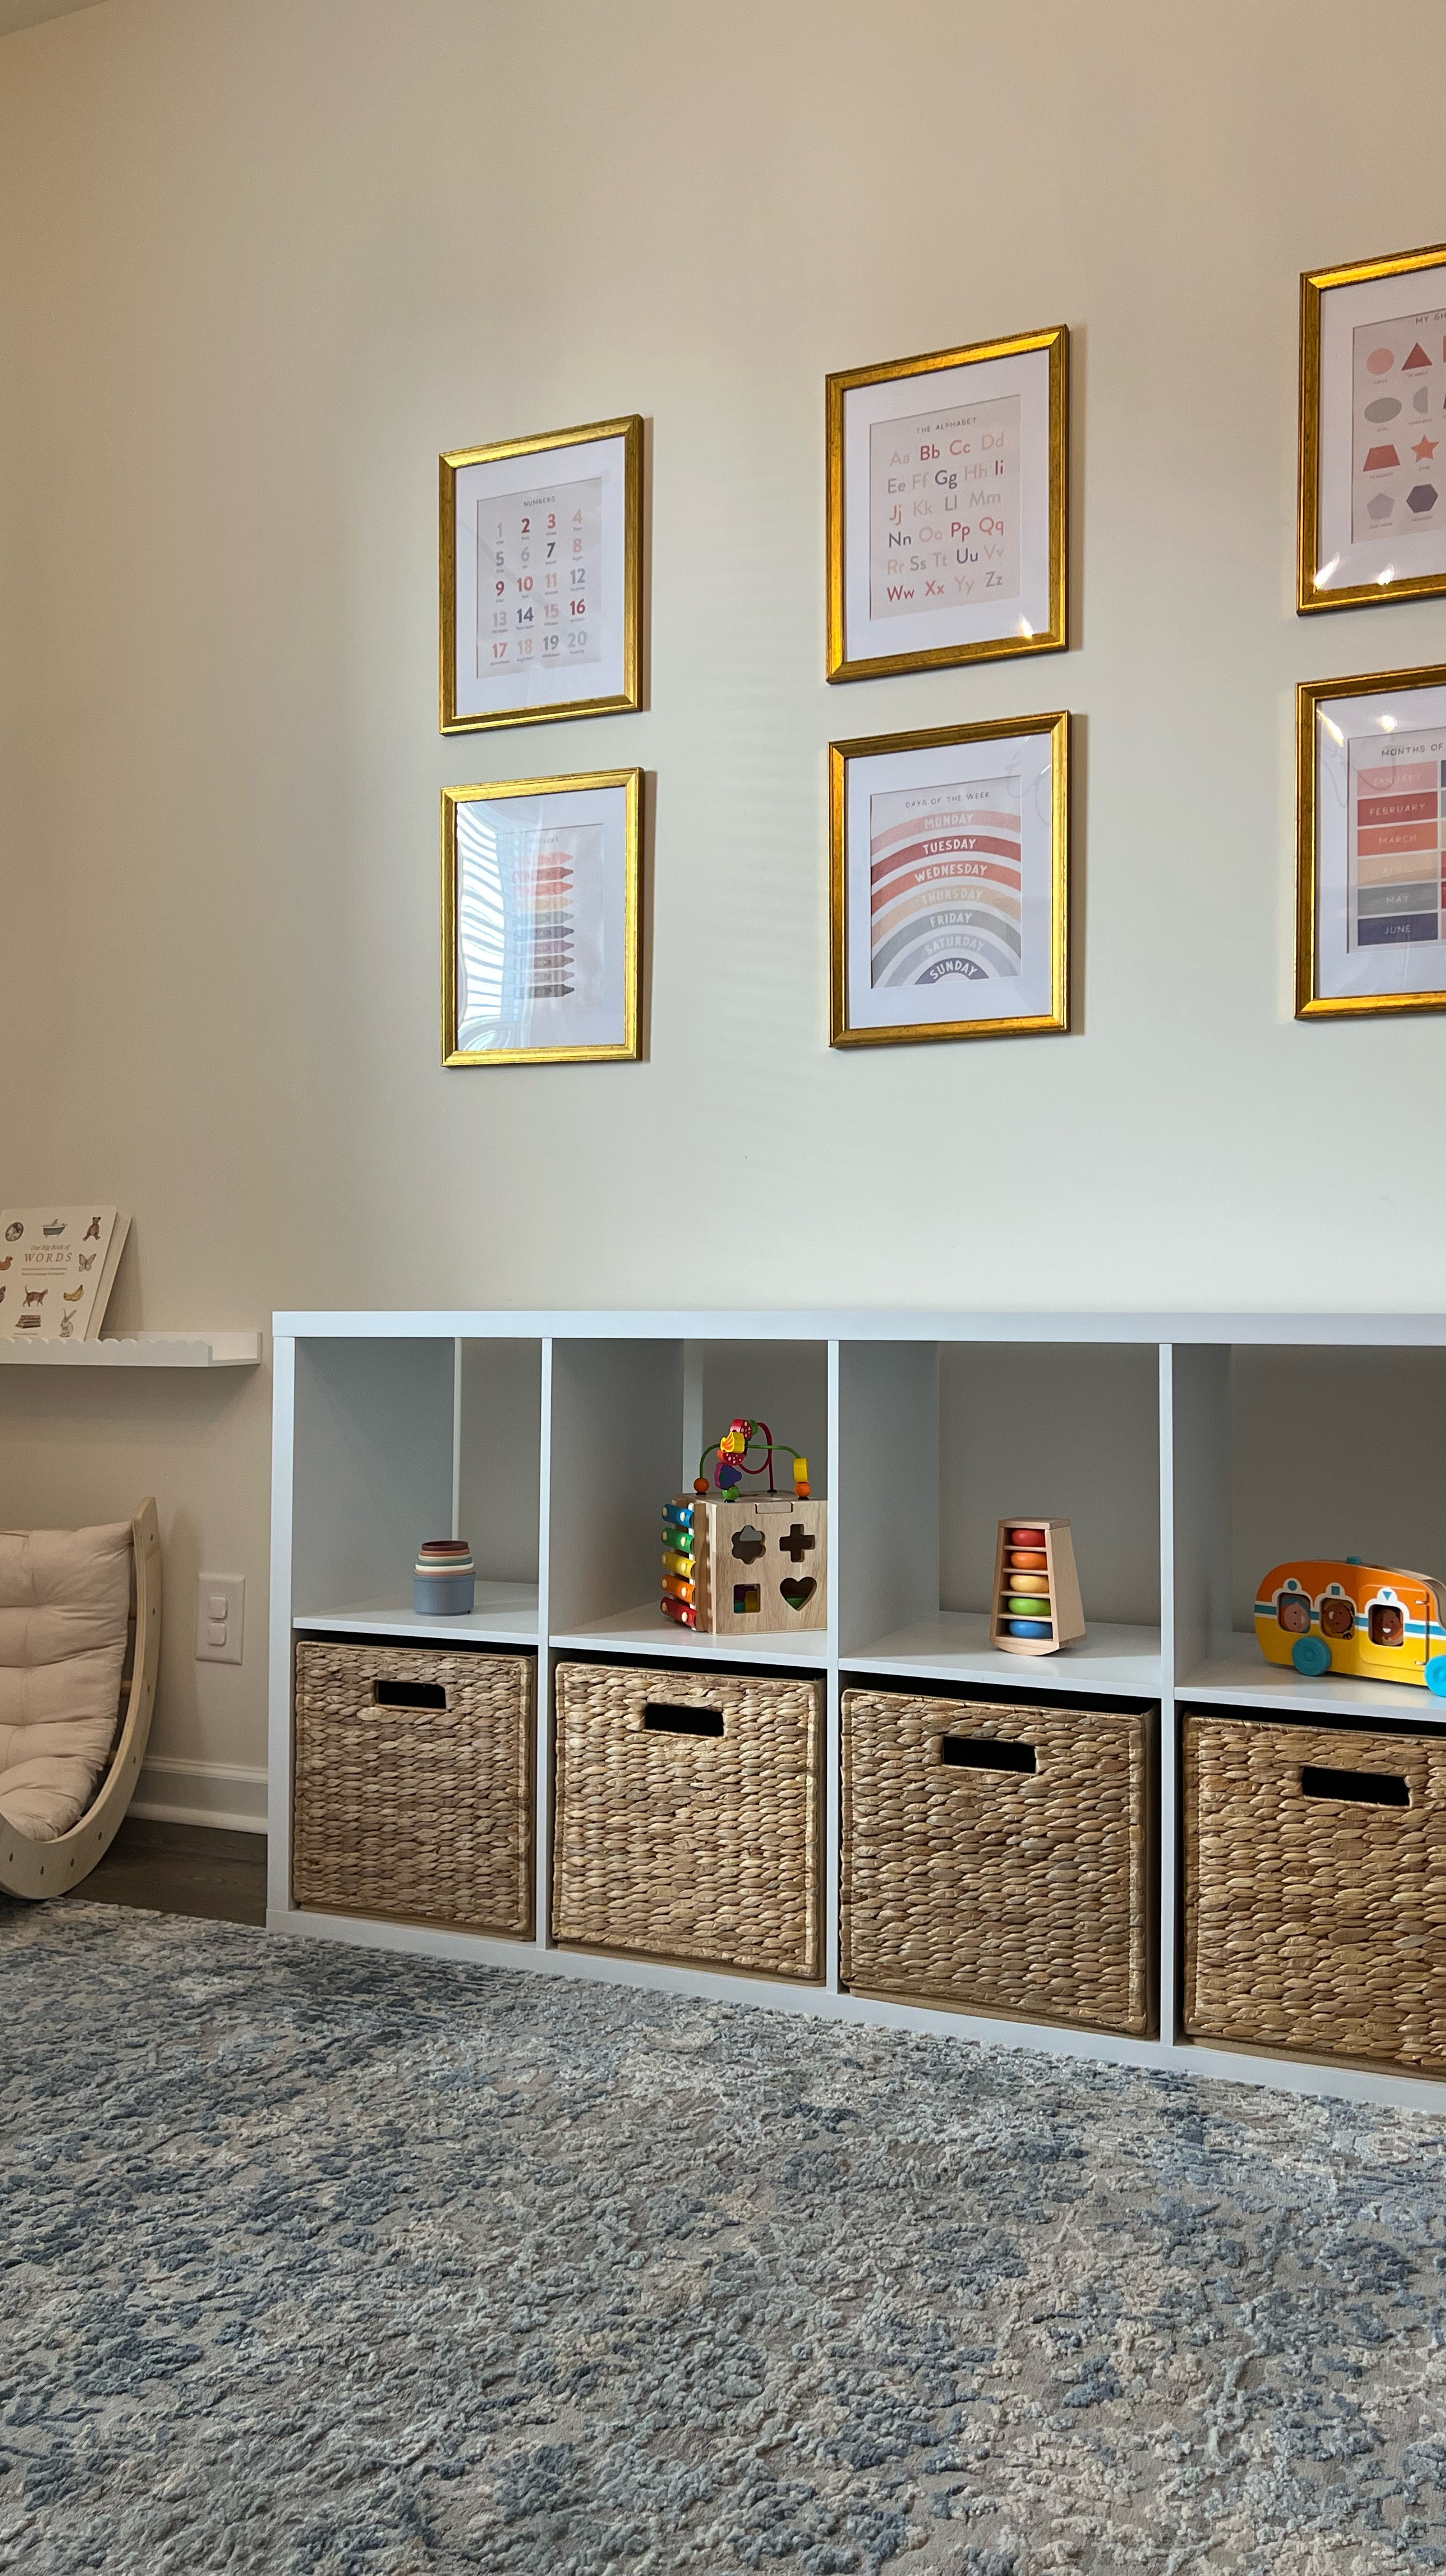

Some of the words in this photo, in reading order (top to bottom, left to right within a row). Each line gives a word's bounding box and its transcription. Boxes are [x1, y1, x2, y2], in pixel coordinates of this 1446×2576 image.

[1415, 316, 1429, 325] MY
[917, 425, 931, 434] THE
[936, 417, 977, 430] ALPHABET
[890, 452, 910, 466] Aa
[920, 444, 940, 461] Bb
[950, 440, 971, 456] Cc
[981, 432, 1004, 450] Dd
[888, 479, 906, 494] Ee
[912, 472, 929, 490] Ff
[934, 470, 957, 489] Gg
[964, 463, 988, 480] Hh
[523, 496, 556, 507] NUMBERS
[890, 505, 902, 526] Jj
[913, 502, 932, 516] Kk
[945, 495, 957, 511] Ll
[969, 490, 1001, 507] Mm
[497, 523, 503, 537] 1
[521, 518, 530, 533] 2
[547, 513, 556, 529] 3
[572, 508, 582, 523] 4
[889, 532, 911, 548] Nn
[951, 522, 970, 542] Pp
[979, 517, 1004, 536] Qq
[496, 551, 504, 566] 5
[521, 546, 529, 562] 6
[547, 542, 556, 558] 7
[573, 538, 582, 553] 8
[887, 559, 905, 574] Rr
[909, 556, 926, 571] Ss
[932, 552, 948, 567] Tt
[957, 548, 978, 564] Uu
[984, 545, 1003, 559] Vv
[496, 581, 505, 596] 9
[517, 576, 533, 592] 10
[545, 572, 557, 588] 11
[570, 568, 586, 584] 12
[887, 585, 915, 601] Ww
[925, 581, 945, 596] Xx
[954, 576, 976, 596] Yy
[986, 571, 1003, 587] Zz
[492, 611, 507, 627] 13
[517, 607, 534, 623] 14
[544, 603, 559, 620] 15
[570, 599, 585, 615] 16
[492, 642, 508, 658] 17
[517, 638, 533, 654] 18
[544, 635, 559, 650] 19
[567, 631, 587, 648] 20
[1381, 745, 1426, 757] MONTHS
[1431, 743, 1443, 751] OF
[906, 800, 927, 808] DAYS
[1369, 803, 1426, 816] FEBRUARY
[924, 813, 975, 829] MONDAY
[923, 839, 977, 854] TUESDAY
[1378, 834, 1417, 845] MARCH
[914, 864, 988, 884] WEDNESDAY
[921, 888, 984, 905] THURSDAY
[1386, 895, 1410, 903] MAY
[930, 912, 972, 928] FRIDAY
[1385, 925, 1410, 934] JUNE
[925, 936, 985, 955] SATURDAY
[930, 960, 978, 980] SUNDAY
[25, 1252, 72, 1262] WORDS
